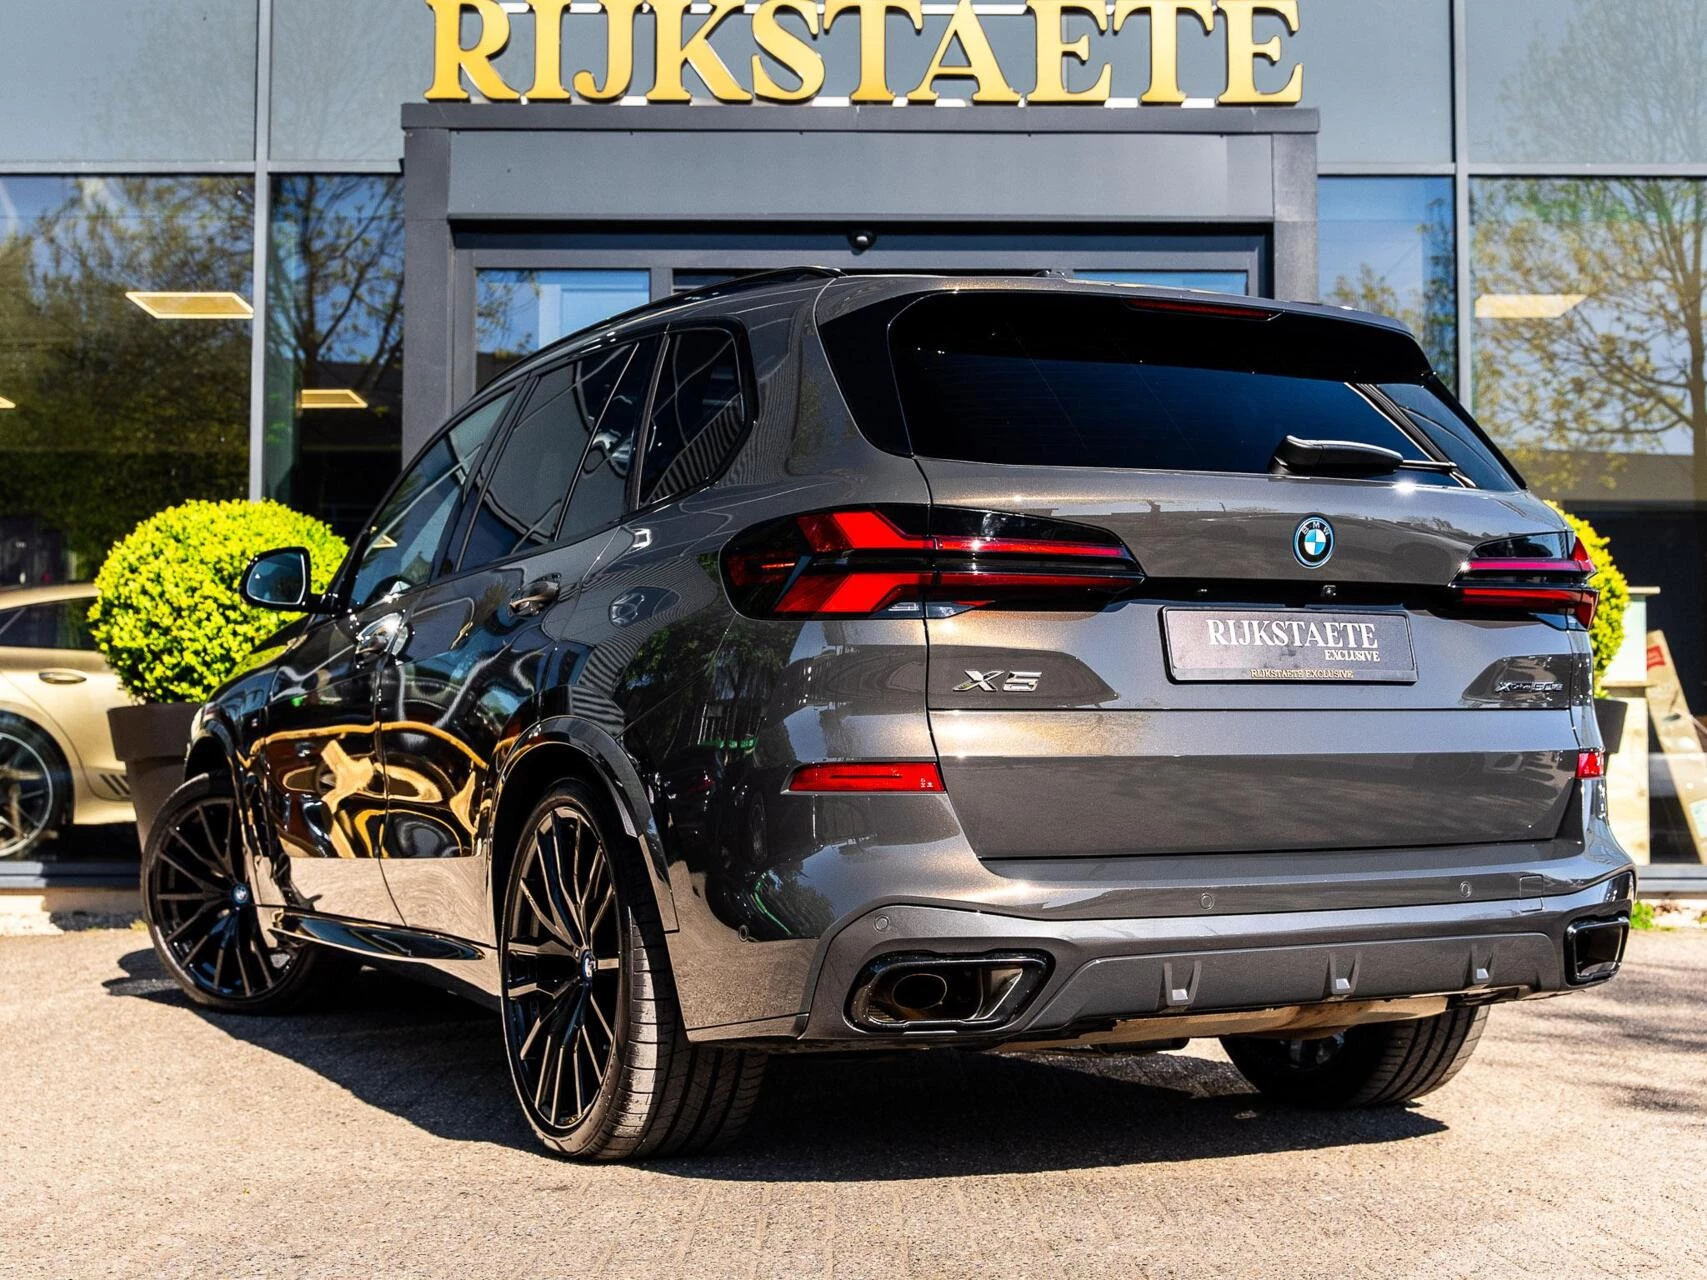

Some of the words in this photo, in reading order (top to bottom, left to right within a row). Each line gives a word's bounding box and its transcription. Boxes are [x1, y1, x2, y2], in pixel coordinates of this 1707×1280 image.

[425, 0, 1304, 106] RIJKSTAETE
[1206, 619, 1378, 649] RIJKSTAETE
[1325, 650, 1380, 661] EXCLUSIVE
[952, 669, 1042, 692] X5
[1251, 669, 1303, 679] RIJKSTAETE
[1305, 669, 1354, 679] EXCLUSIVE
